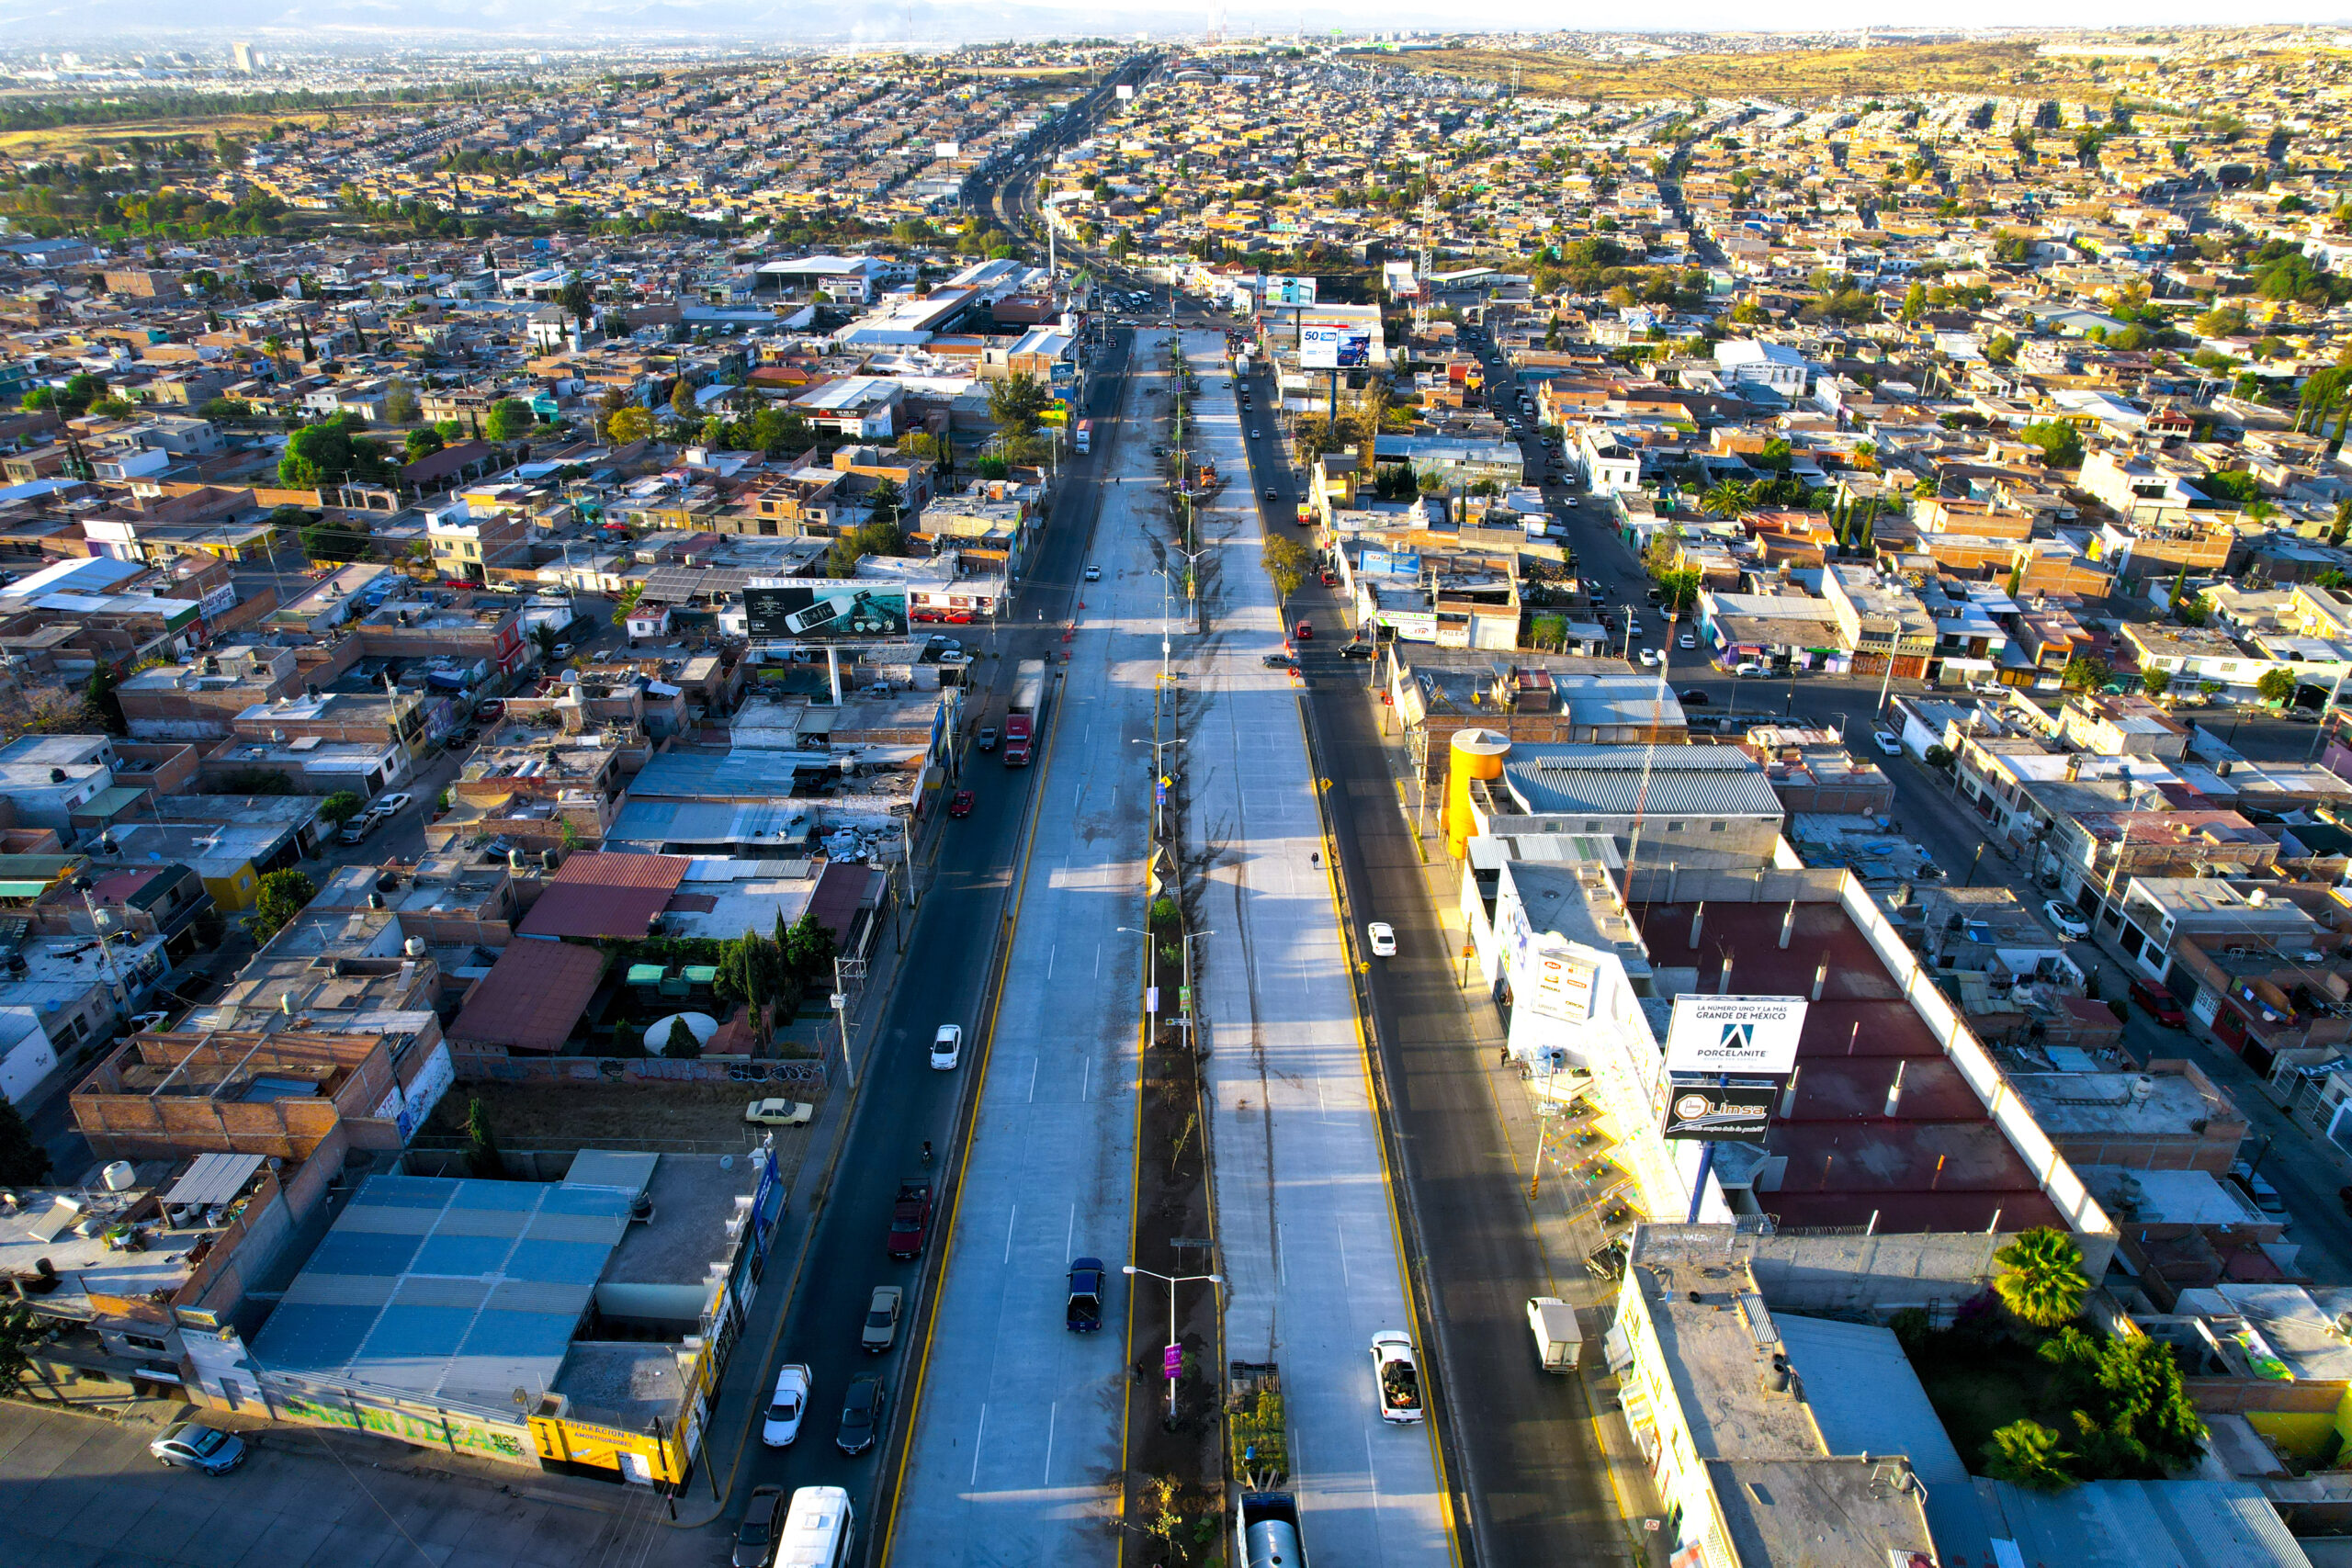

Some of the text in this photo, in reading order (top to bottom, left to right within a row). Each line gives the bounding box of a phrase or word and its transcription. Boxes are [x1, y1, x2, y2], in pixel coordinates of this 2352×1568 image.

[1305, 331, 1318, 341] 50
[1696, 1011, 1734, 1020] GRANDE
[1749, 1011, 1787, 1021] MÉXICO
[1697, 1049, 1766, 1057] PORCELANITE
[564, 1420, 627, 1438] REPARACION
[574, 1431, 634, 1448] AMORTIGUADORES
